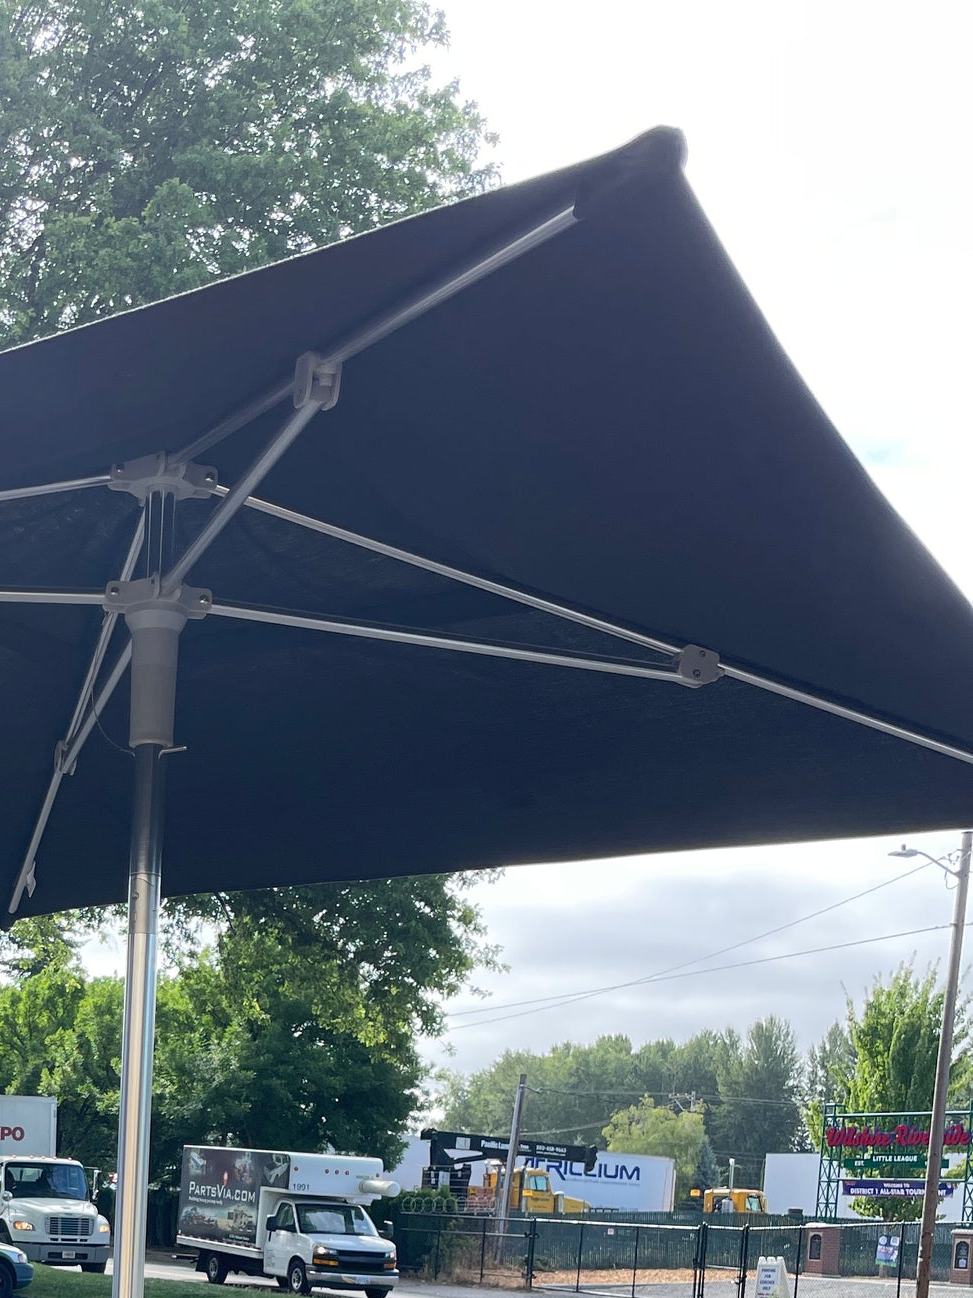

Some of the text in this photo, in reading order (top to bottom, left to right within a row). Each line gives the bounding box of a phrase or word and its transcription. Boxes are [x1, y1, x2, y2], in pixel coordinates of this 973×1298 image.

[826, 1124, 970, 1146] Wilshire Riveide
[850, 1187, 874, 1195] DISTRICT
[879, 1188, 905, 1196] ALL-STAR
